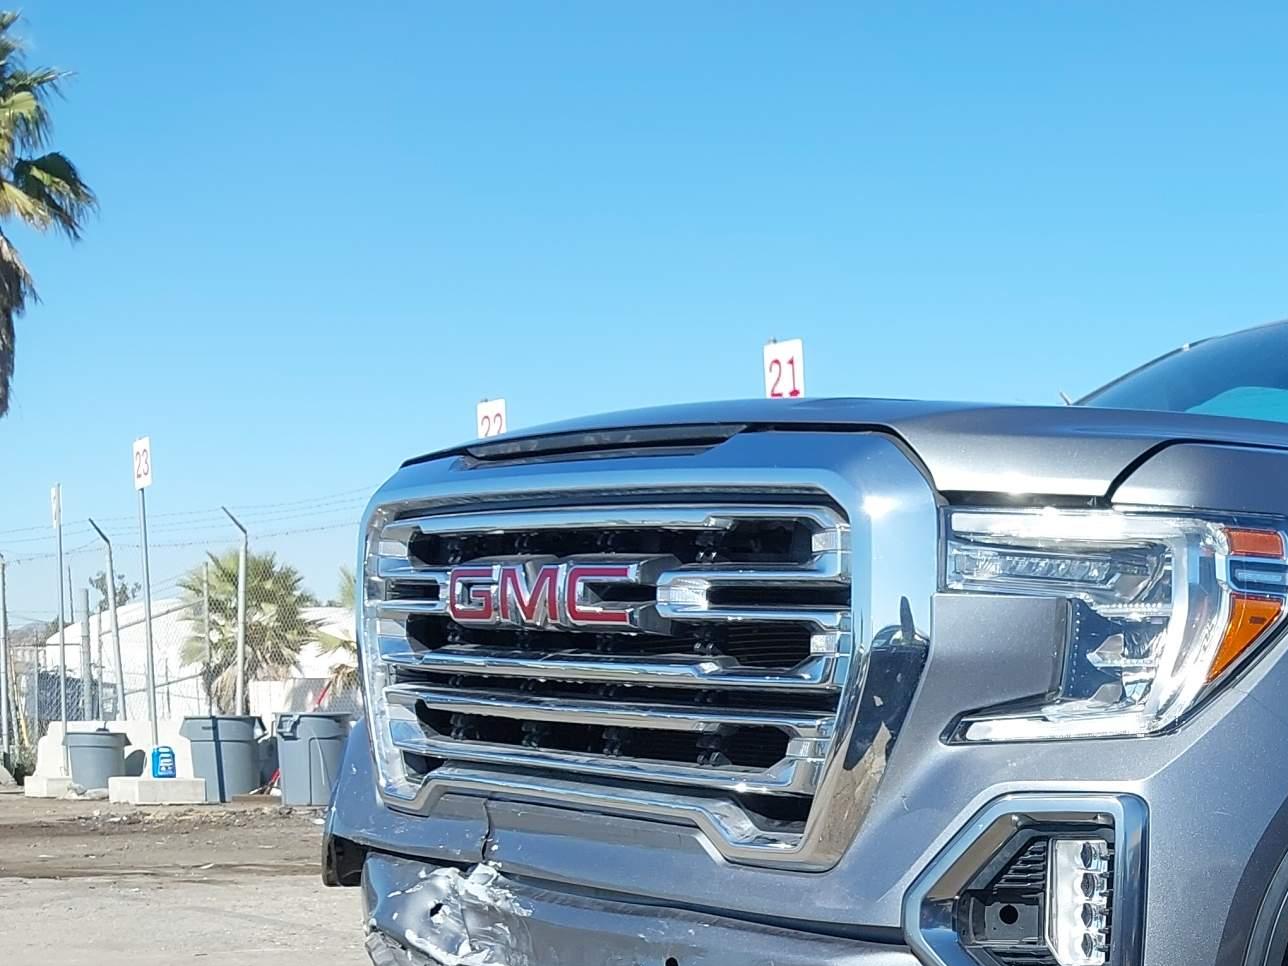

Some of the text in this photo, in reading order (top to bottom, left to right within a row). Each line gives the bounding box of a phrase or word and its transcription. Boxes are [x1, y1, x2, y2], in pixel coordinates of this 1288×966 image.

[769, 355, 801, 398] 21
[135, 448, 150, 479] 23
[448, 563, 636, 627] GMC
